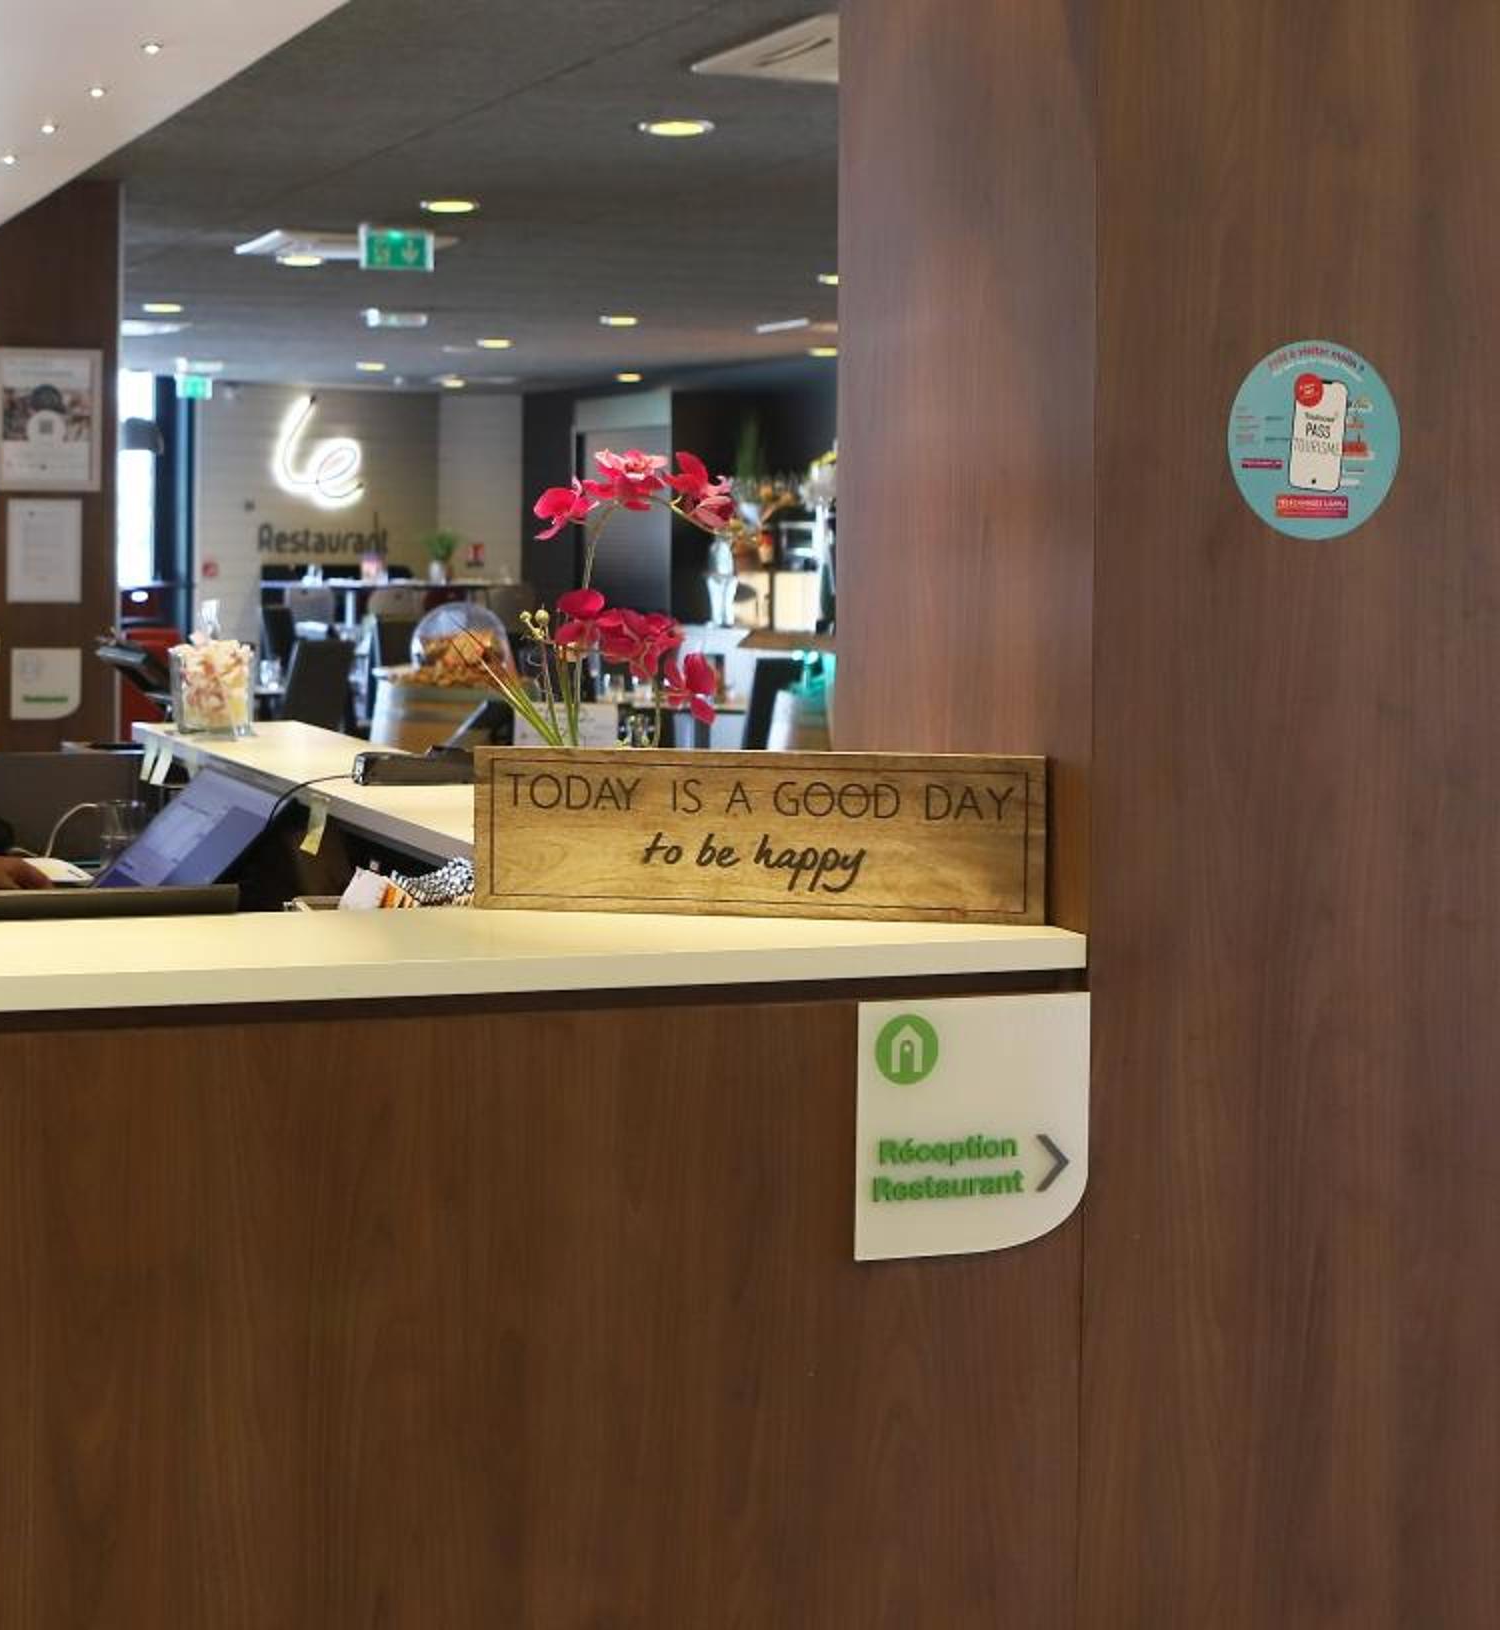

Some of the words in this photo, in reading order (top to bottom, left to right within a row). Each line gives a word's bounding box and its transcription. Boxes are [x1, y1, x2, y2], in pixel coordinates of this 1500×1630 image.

[1305, 421, 1331, 439] PASS
[257, 522, 389, 554] Restaurant
[505, 772, 642, 811] TODAY
[671, 778, 703, 814] IS
[725, 780, 754, 815] A
[772, 780, 901, 819] GOOD
[924, 784, 1017, 821] DAY
[642, 831, 684, 865] to
[695, 832, 741, 868] be
[753, 832, 867, 893] happy
[877, 1133, 1018, 1167] Réception
[871, 1170, 1025, 1203] Restaurant
